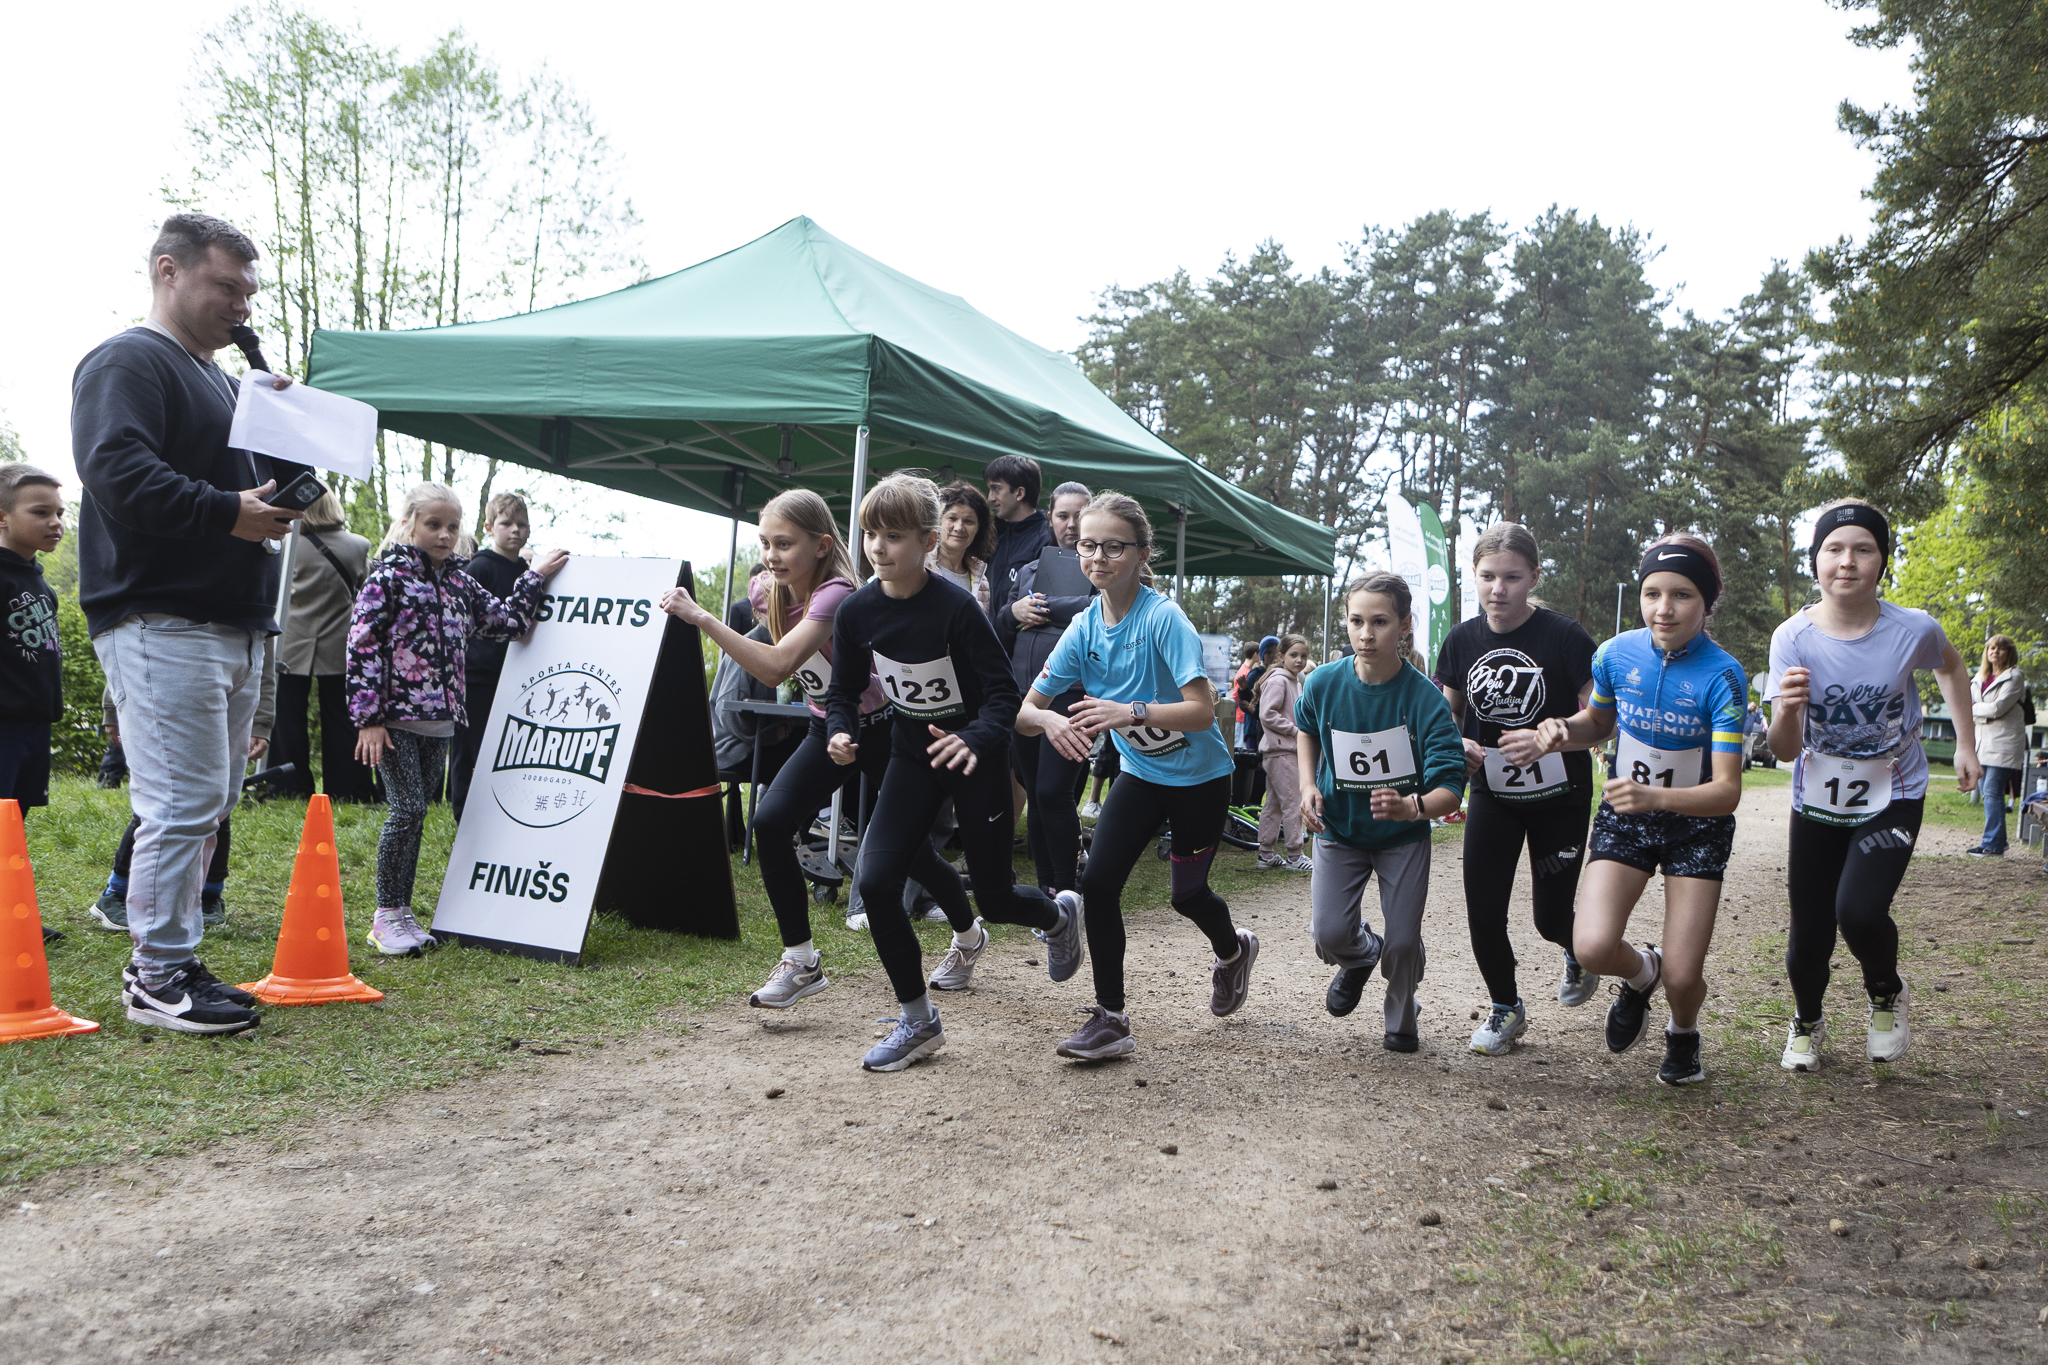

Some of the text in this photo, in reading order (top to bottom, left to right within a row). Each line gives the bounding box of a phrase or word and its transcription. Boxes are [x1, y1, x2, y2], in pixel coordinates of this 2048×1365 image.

[8, 598, 53, 632] CHILL
[9, 591, 37, 611] LA
[535, 594, 651, 628] STARTS
[22, 618, 56, 648] OUT
[521, 662, 622, 695] SPORTA CENTRS
[885, 674, 951, 704] 123
[1722, 668, 1743, 707] DEMIURG
[1808, 692, 1905, 726] DAYS
[1823, 684, 1891, 706] Every
[933, 707, 956, 717] CENTRS
[1126, 726, 1171, 747] 10
[1349, 749, 1391, 776] 61
[1502, 761, 1544, 787] 21
[1631, 760, 1675, 789] 81
[1388, 779, 1410, 788] CENTRS
[1541, 787, 1562, 797] CENTRS
[1824, 776, 1870, 808] 12
[469, 860, 570, 903] FINIŠS
